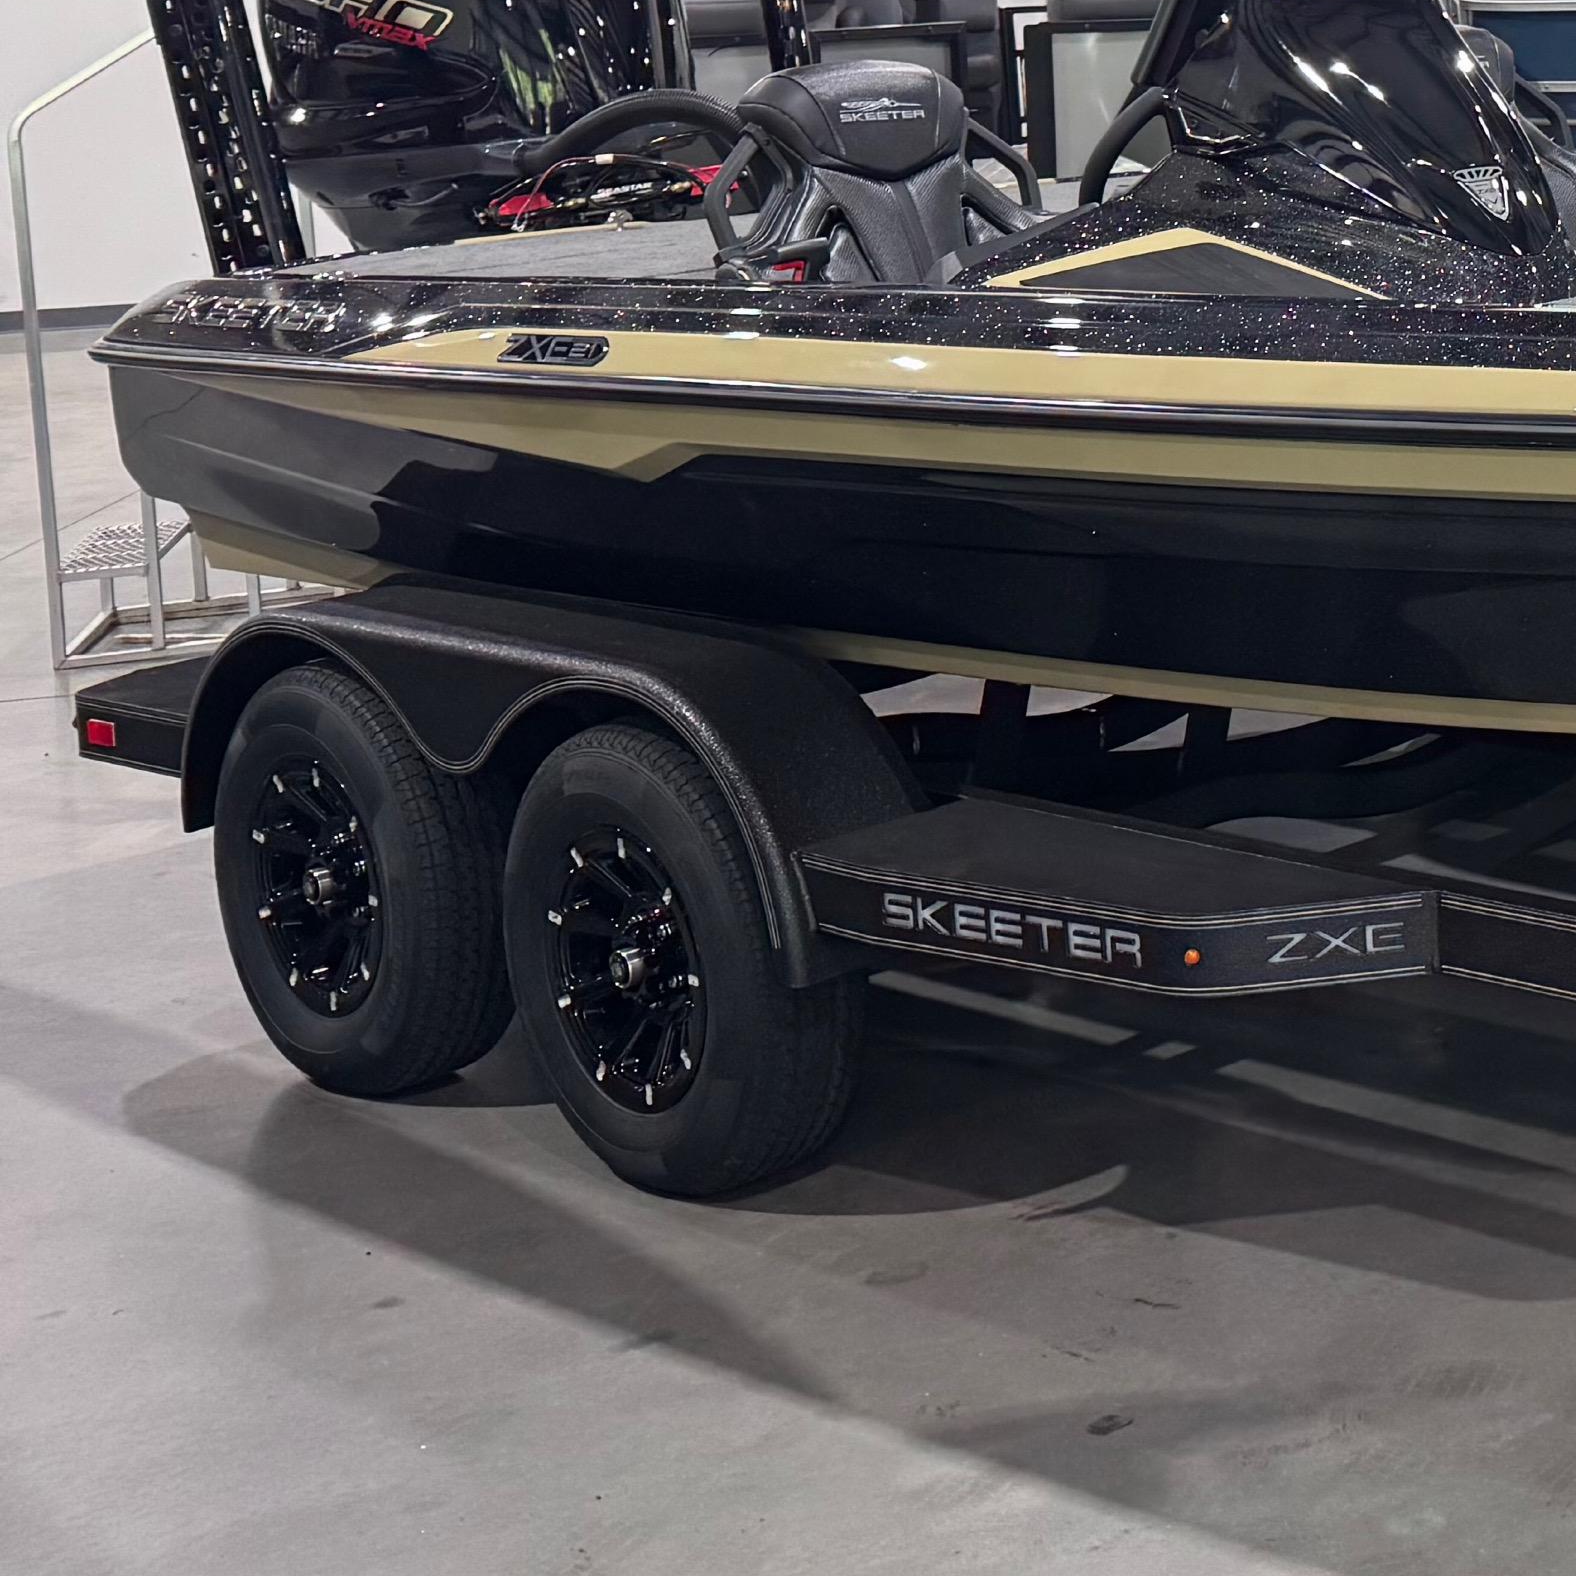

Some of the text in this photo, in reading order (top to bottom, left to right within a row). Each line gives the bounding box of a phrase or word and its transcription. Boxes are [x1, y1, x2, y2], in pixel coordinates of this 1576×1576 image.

[839, 109, 926, 123] SKEETER
[151, 294, 347, 333] SKEETER
[882, 892, 1406, 969] SKEETER ZXE
